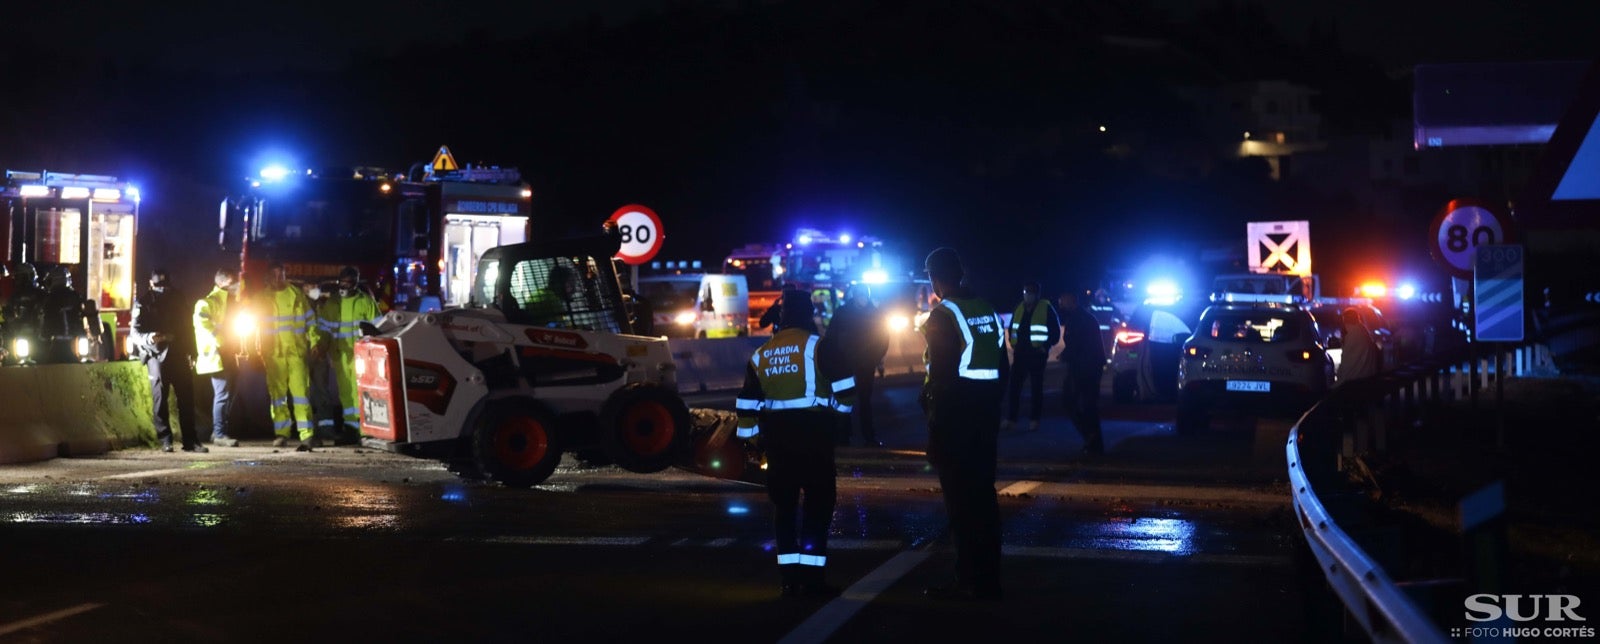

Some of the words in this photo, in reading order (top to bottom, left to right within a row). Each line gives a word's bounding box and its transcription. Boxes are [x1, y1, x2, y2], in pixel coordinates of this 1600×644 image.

[620, 225, 650, 243] 80
[1447, 225, 1494, 252] 80
[1480, 248, 1517, 263] 300
